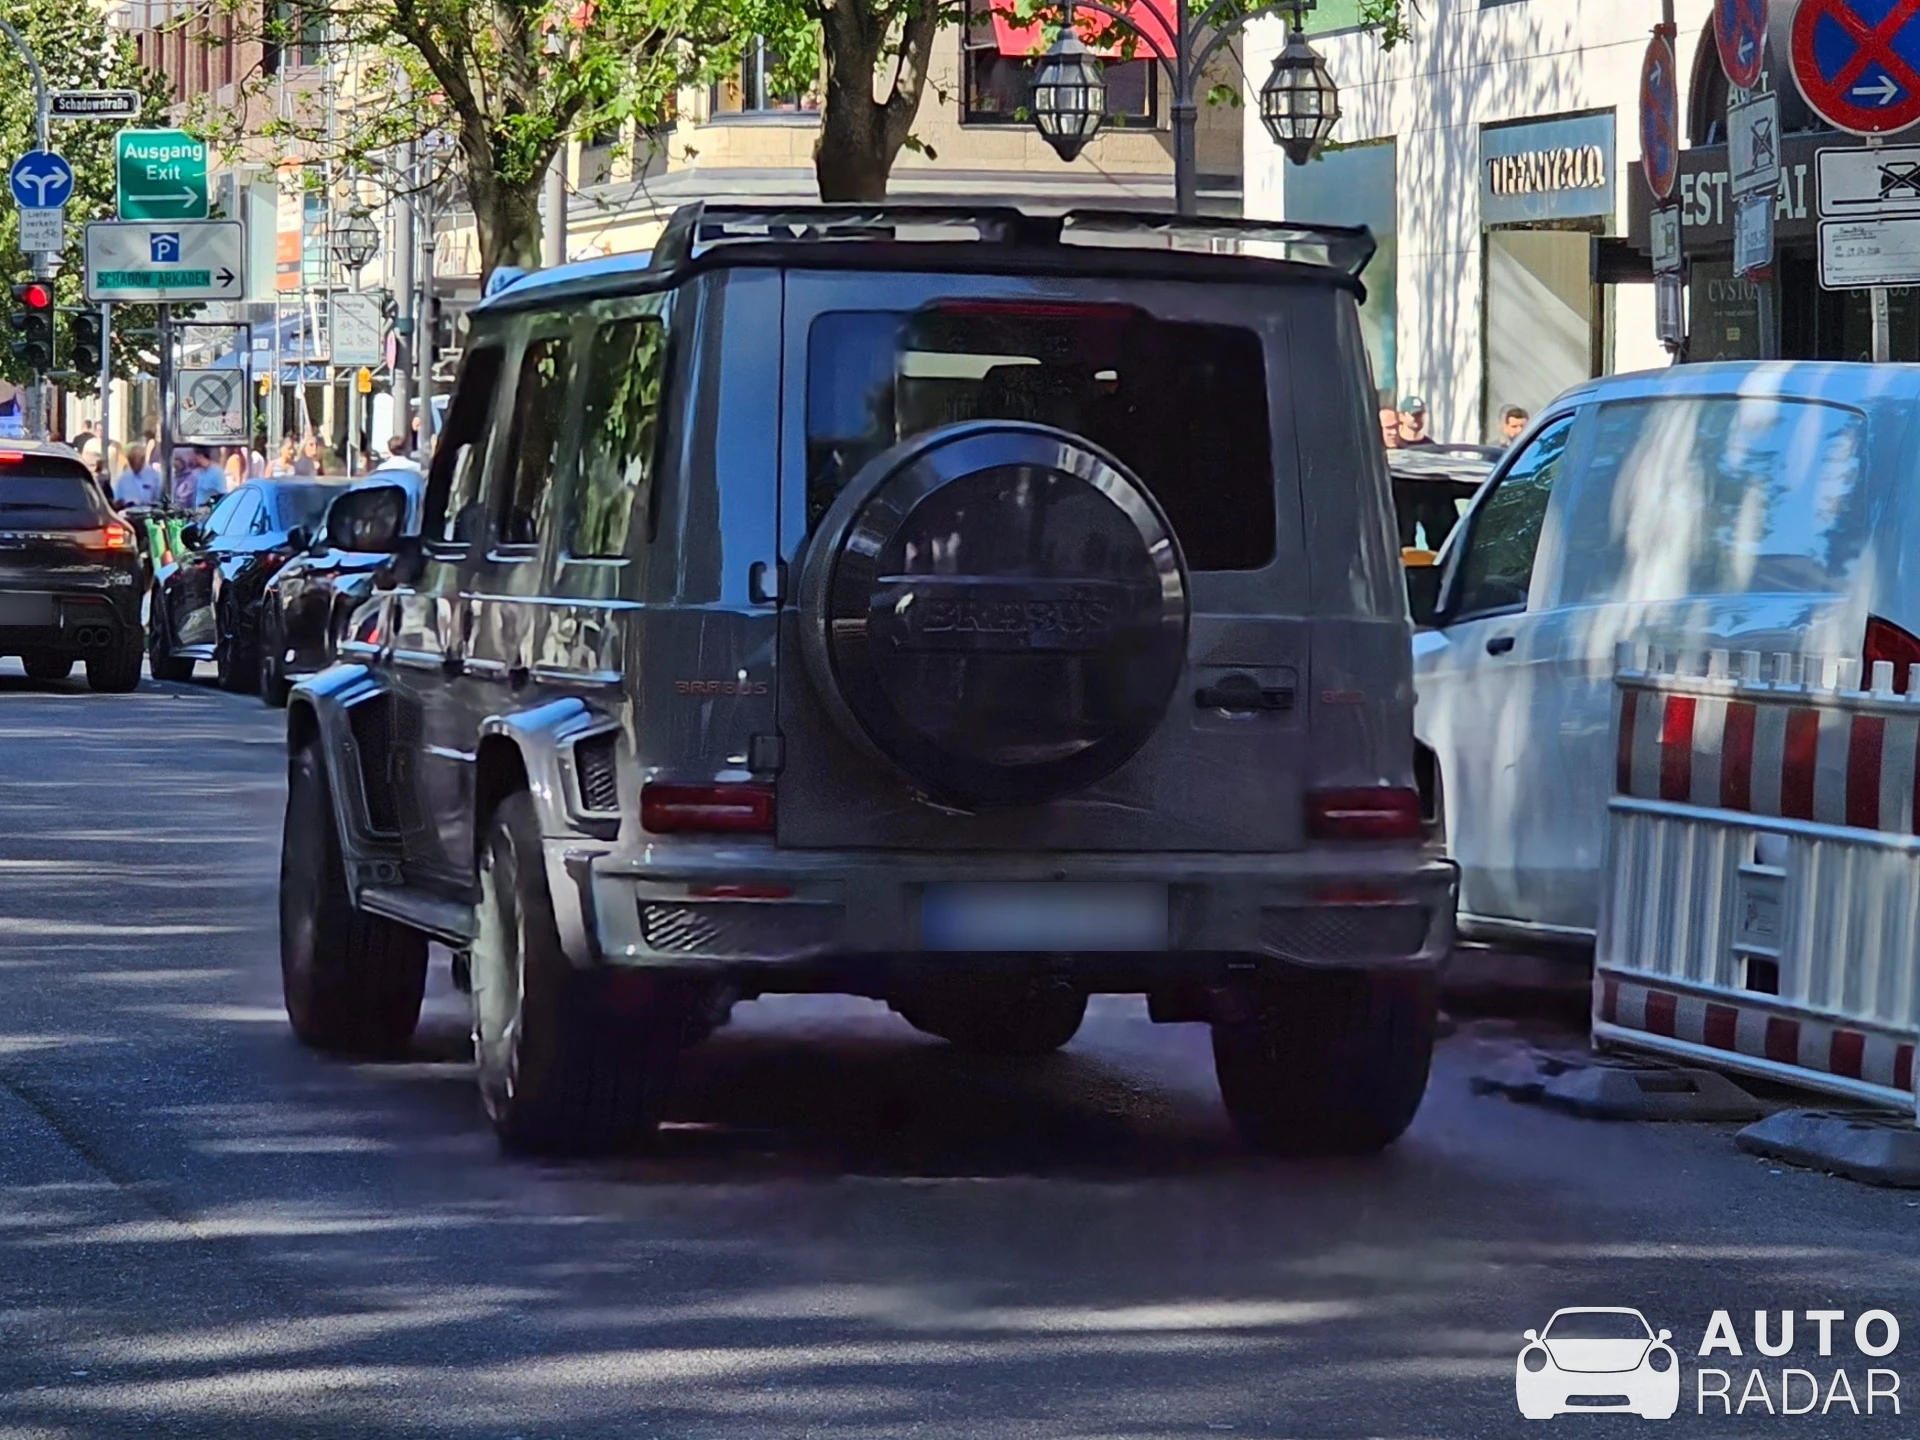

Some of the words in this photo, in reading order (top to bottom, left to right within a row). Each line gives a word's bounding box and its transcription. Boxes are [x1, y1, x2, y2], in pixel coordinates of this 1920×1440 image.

[59, 97, 129, 110] Schadowstraße
[124, 142, 203, 161] Ausgang
[146, 164, 181, 180] Exit
[26, 219, 58, 228] verkehr
[34, 240, 50, 248] frei
[157, 242, 171, 260] P
[97, 270, 151, 287] SCHADOW
[158, 270, 210, 287] ARKADEN
[675, 680, 768, 695] BRABUS
